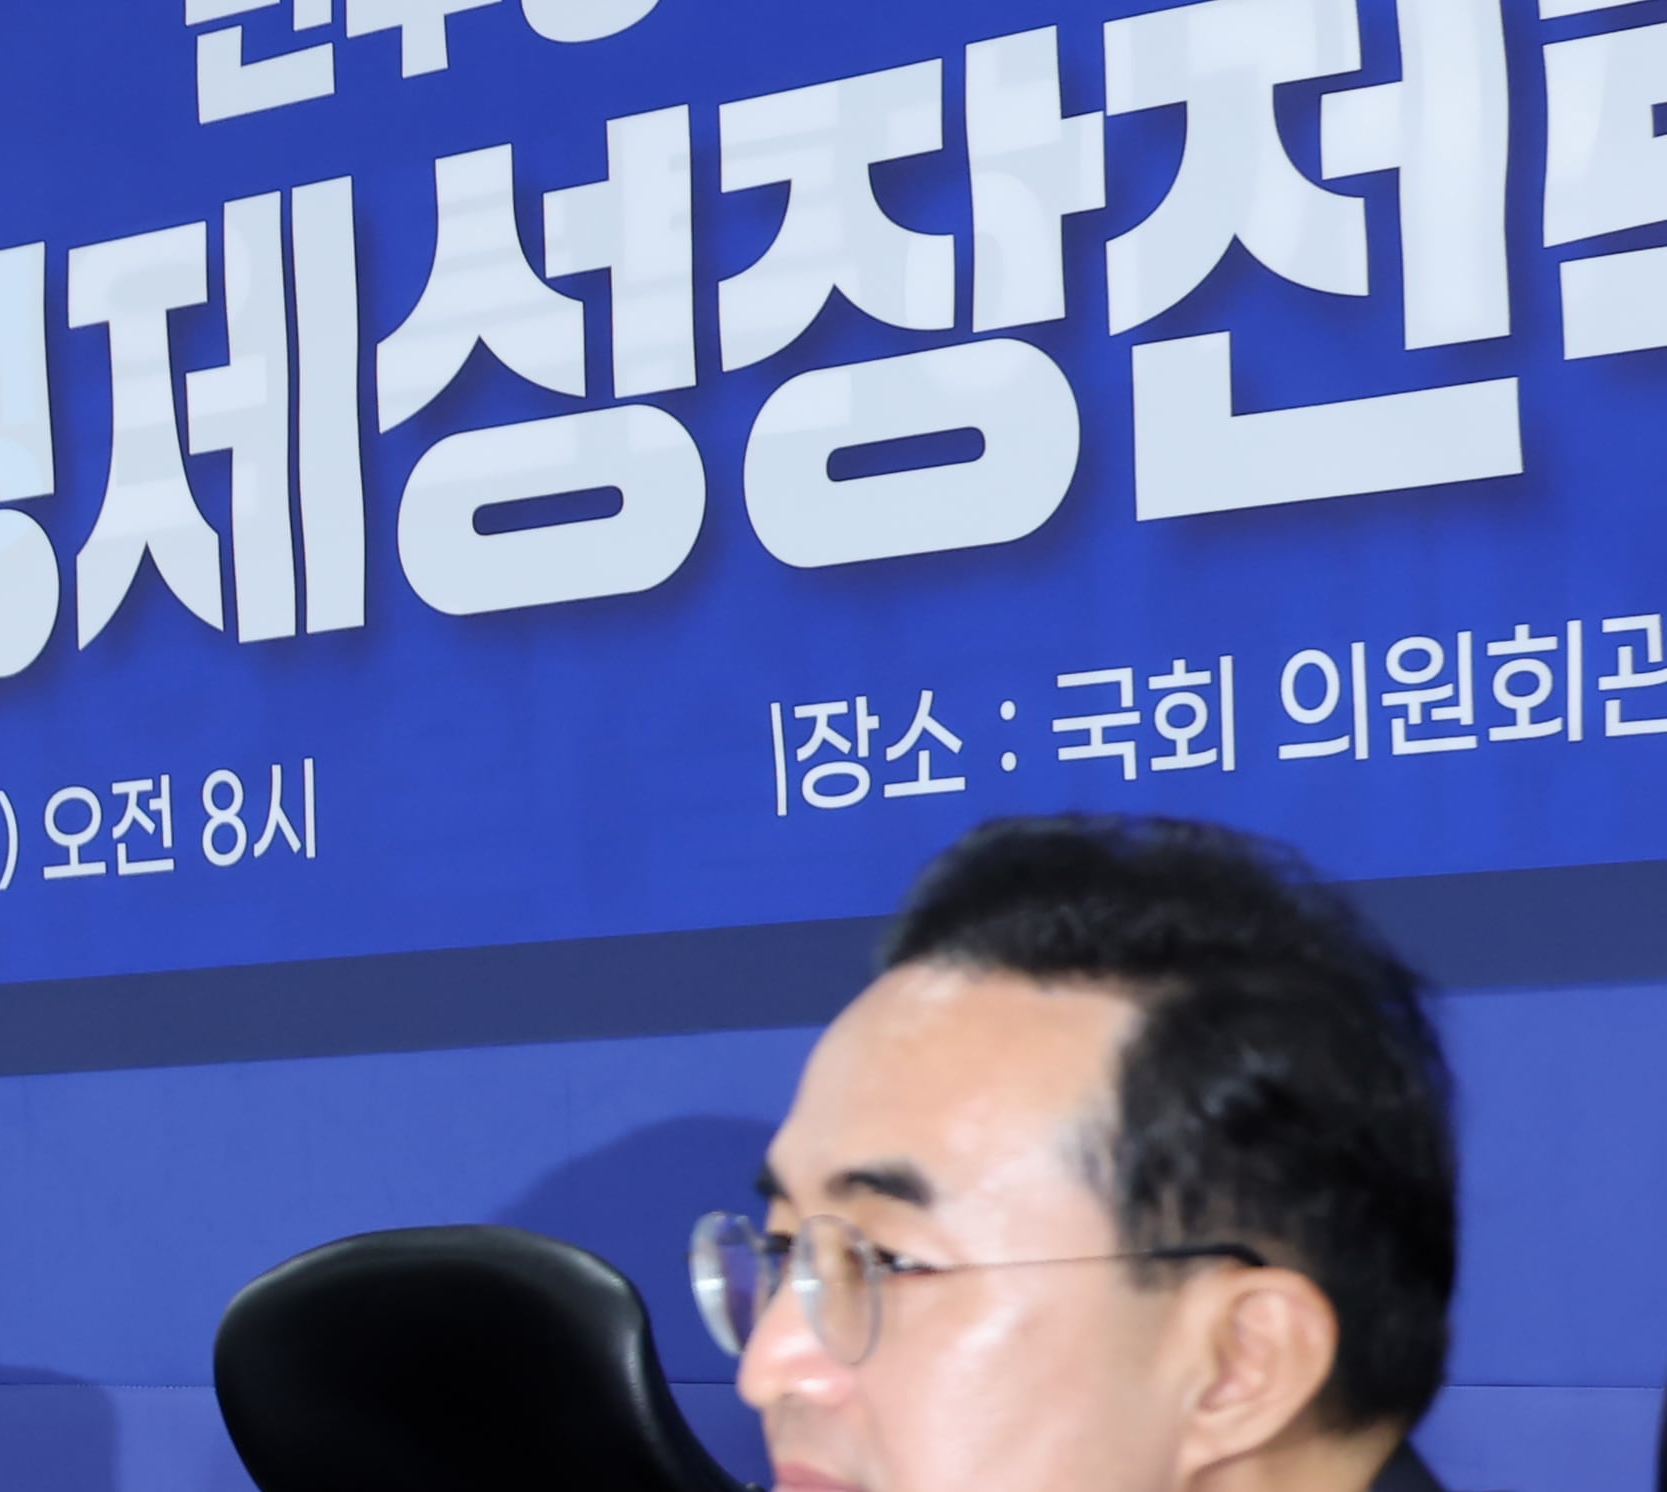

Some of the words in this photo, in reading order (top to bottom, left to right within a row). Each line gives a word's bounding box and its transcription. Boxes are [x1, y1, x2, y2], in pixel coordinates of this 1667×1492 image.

[1053, 656, 1234, 780] 국회
[44, 775, 174, 879] 오전
[203, 758, 315, 866] 8시
